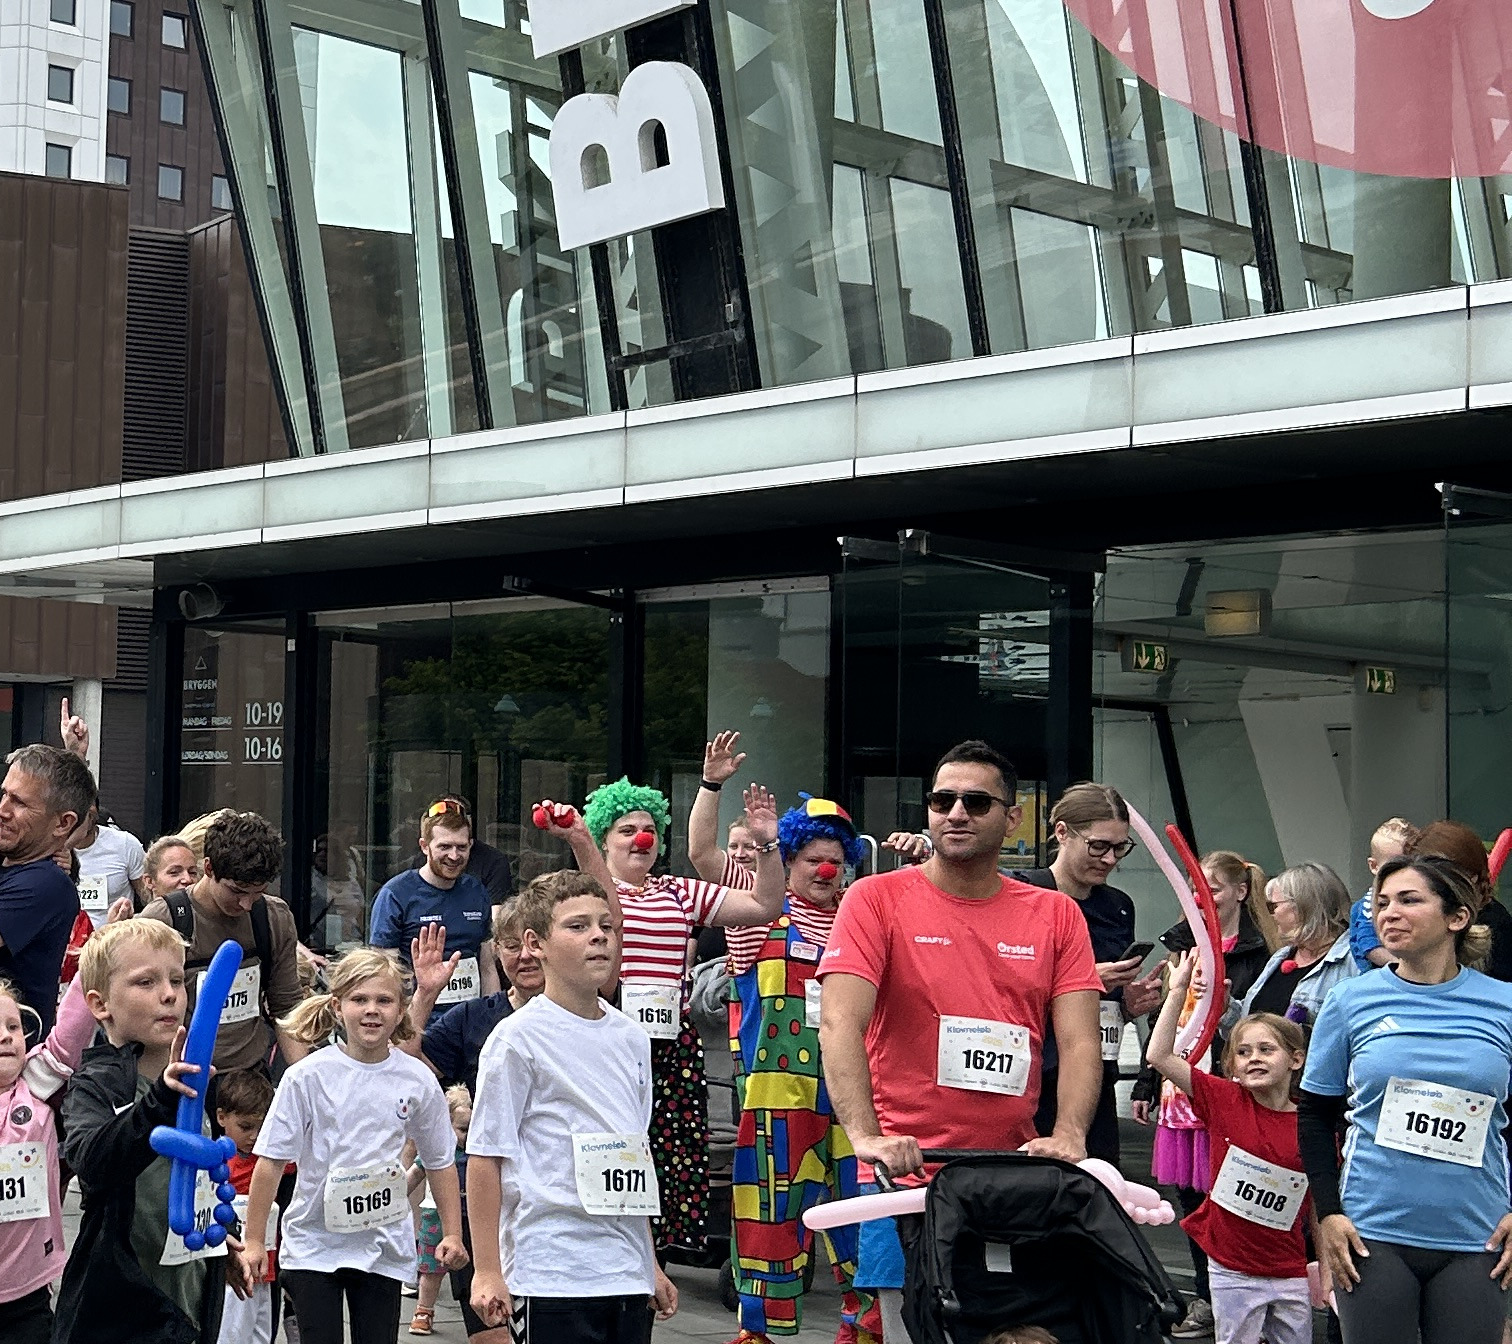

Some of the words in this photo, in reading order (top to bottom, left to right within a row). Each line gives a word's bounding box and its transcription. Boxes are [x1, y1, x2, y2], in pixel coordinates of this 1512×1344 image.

[245, 701, 284, 725] 10-19
[244, 736, 283, 760] 10-16
[79, 889, 99, 900] 223
[637, 1007, 673, 1025] 16158
[962, 1049, 1014, 1074] 16217
[1405, 1111, 1467, 1143] 16192
[601, 1168, 647, 1193] 16171
[343, 1187, 392, 1215] 16169
[1234, 1179, 1288, 1213] 16108
